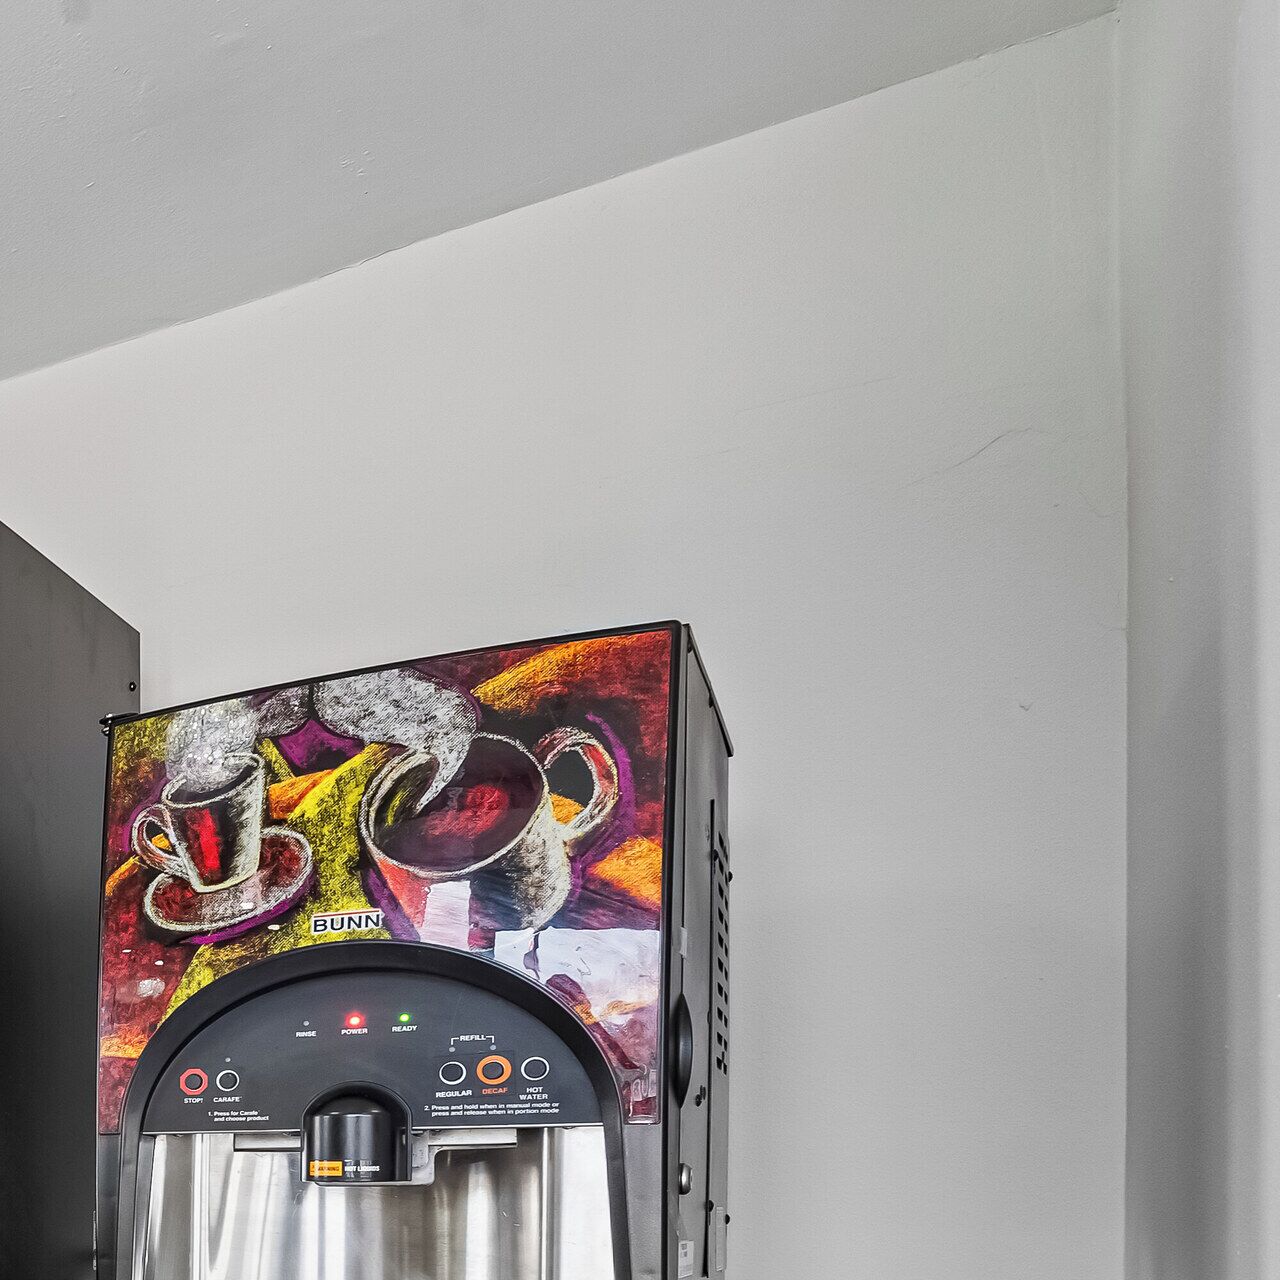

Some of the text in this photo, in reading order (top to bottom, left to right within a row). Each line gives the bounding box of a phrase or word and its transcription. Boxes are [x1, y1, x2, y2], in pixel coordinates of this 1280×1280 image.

[313, 913, 381, 933] BUNN
[295, 1030, 317, 1038] RINSE
[459, 1034, 487, 1042] REFILL
[435, 1089, 473, 1098] REGULAR
[481, 1087, 509, 1095] DECAF
[519, 1093, 549, 1101] WATER
